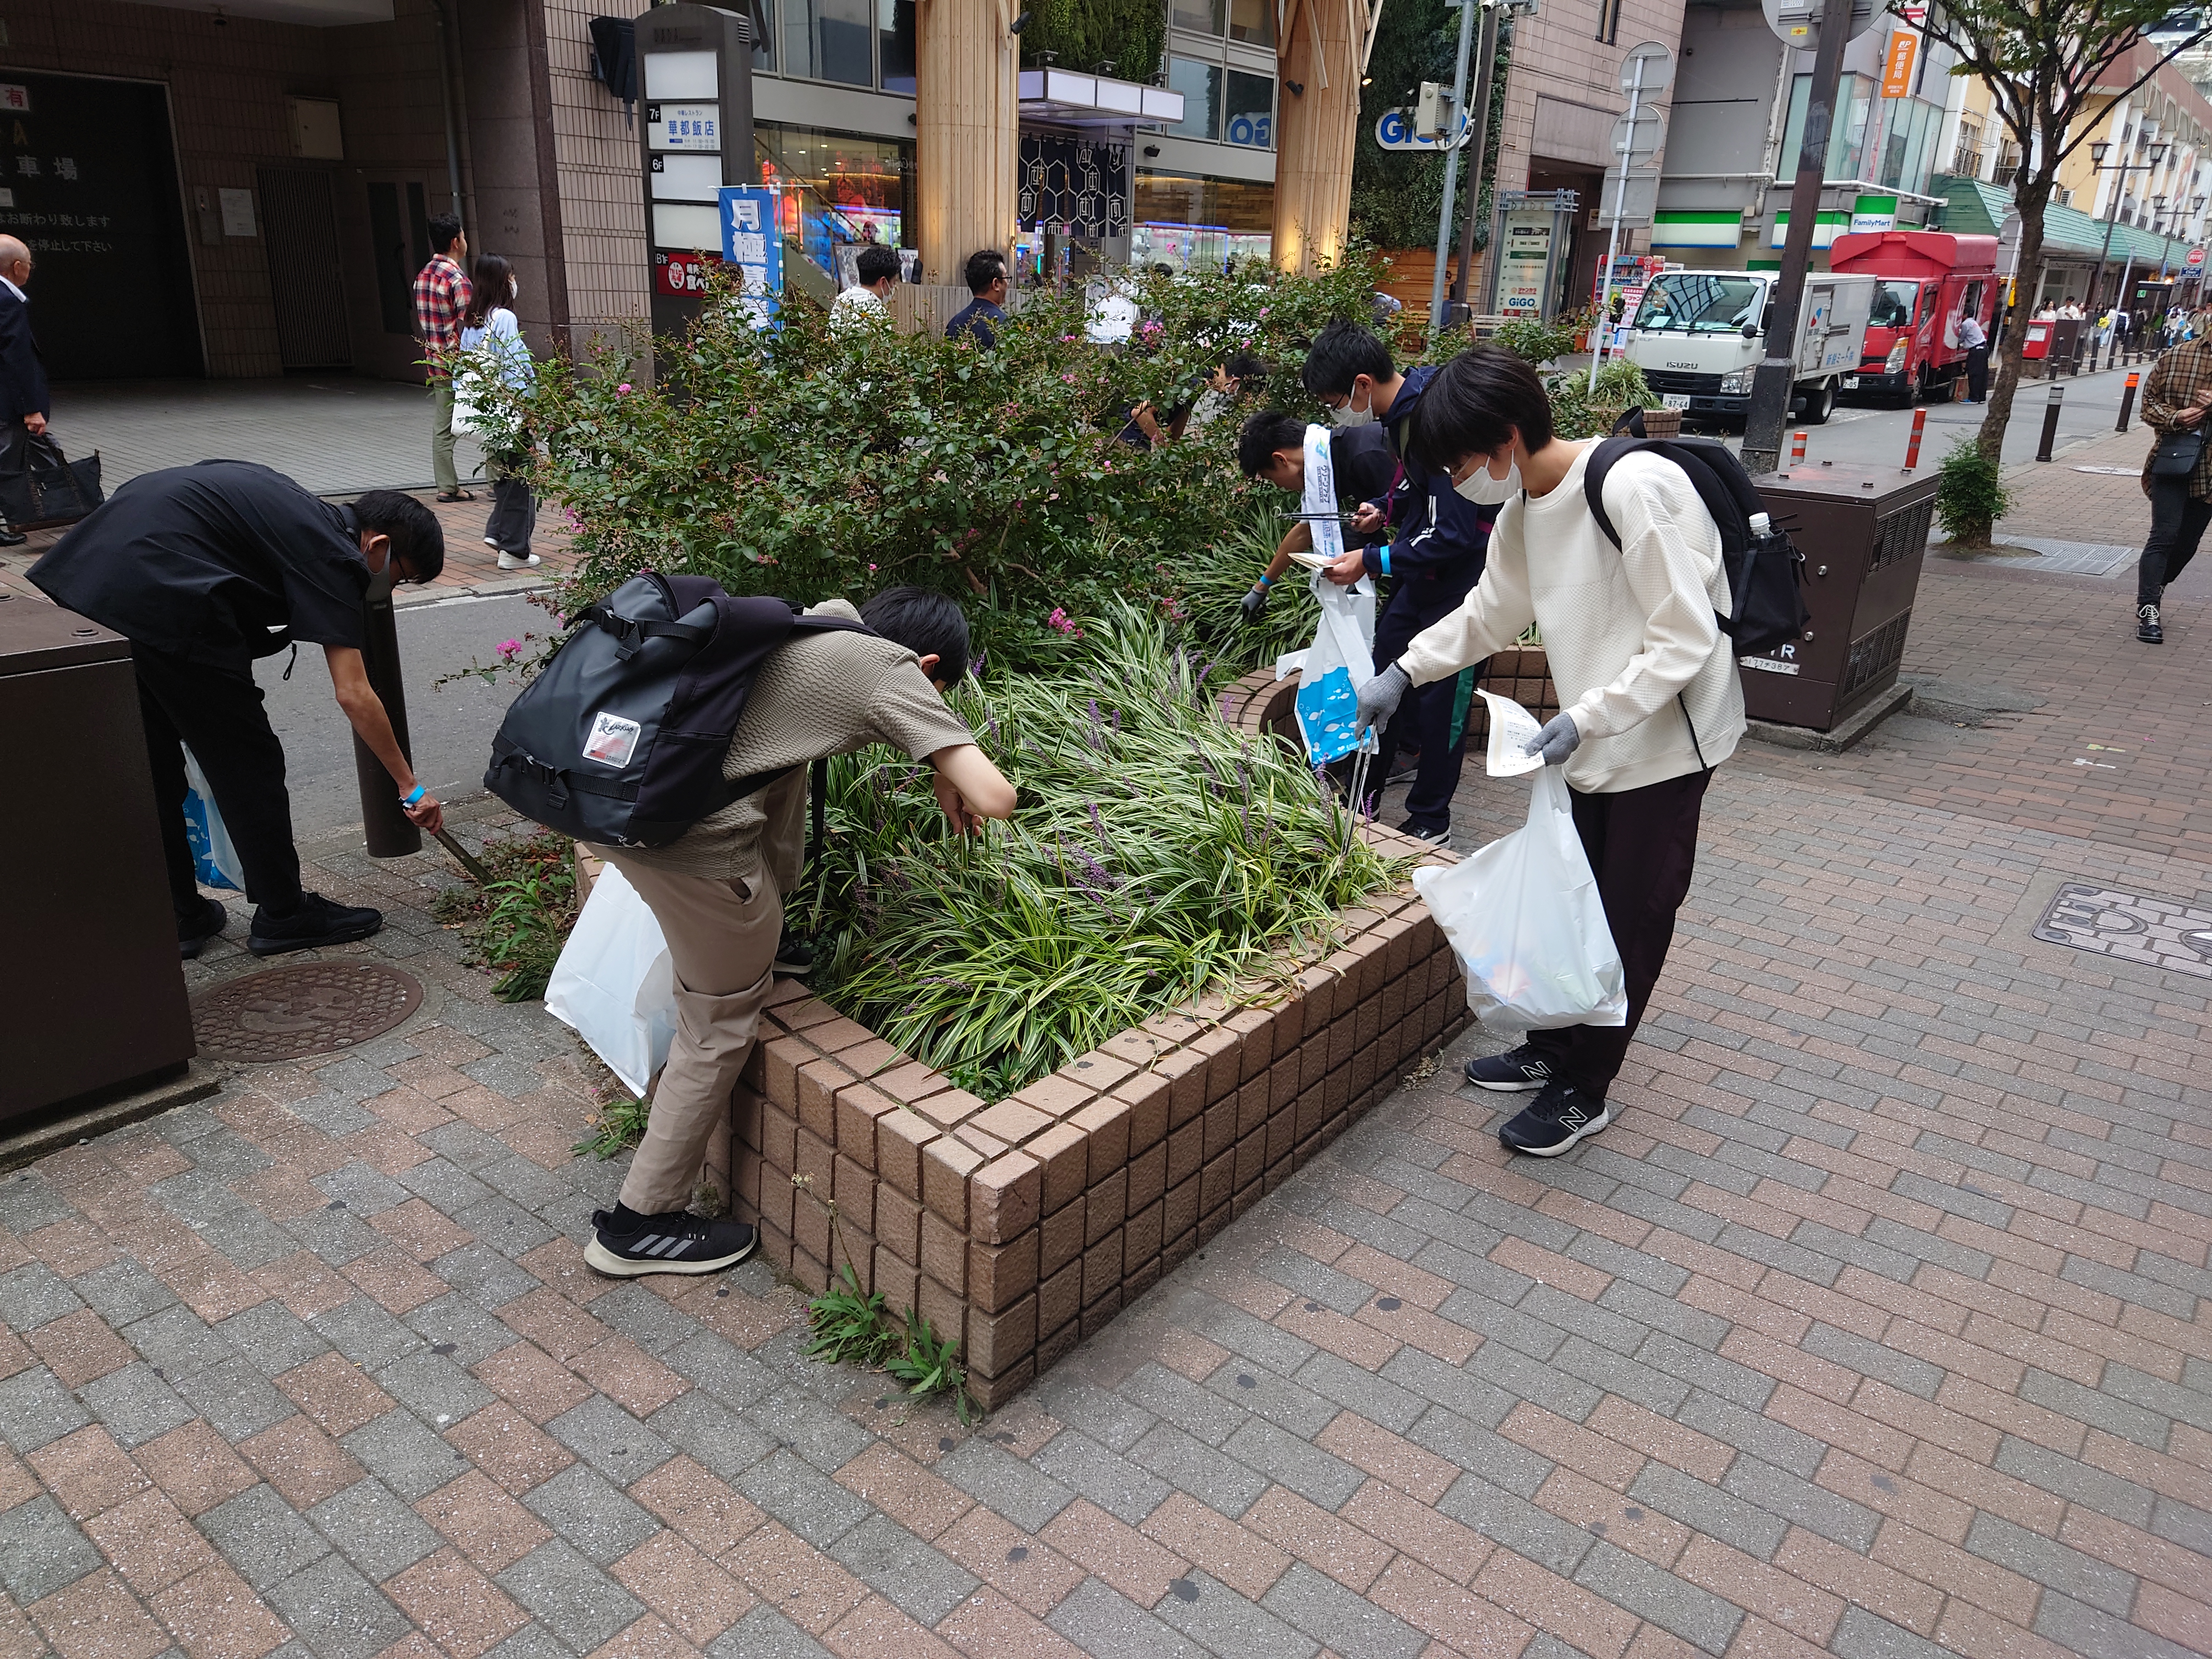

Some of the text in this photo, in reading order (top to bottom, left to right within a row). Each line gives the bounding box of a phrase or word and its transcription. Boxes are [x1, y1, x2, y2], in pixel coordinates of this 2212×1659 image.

[1893, 52, 1906, 79] 郵便局
[5, 88, 24, 108] 有
[649, 108, 659, 120] 7F
[668, 120, 714, 136] 華都飯店
[0, 154, 77, 180] 車場
[652, 158, 663, 171] 6F
[1854, 219, 1891, 228] FamilyMart
[1509, 298, 1535, 307] GiGO
